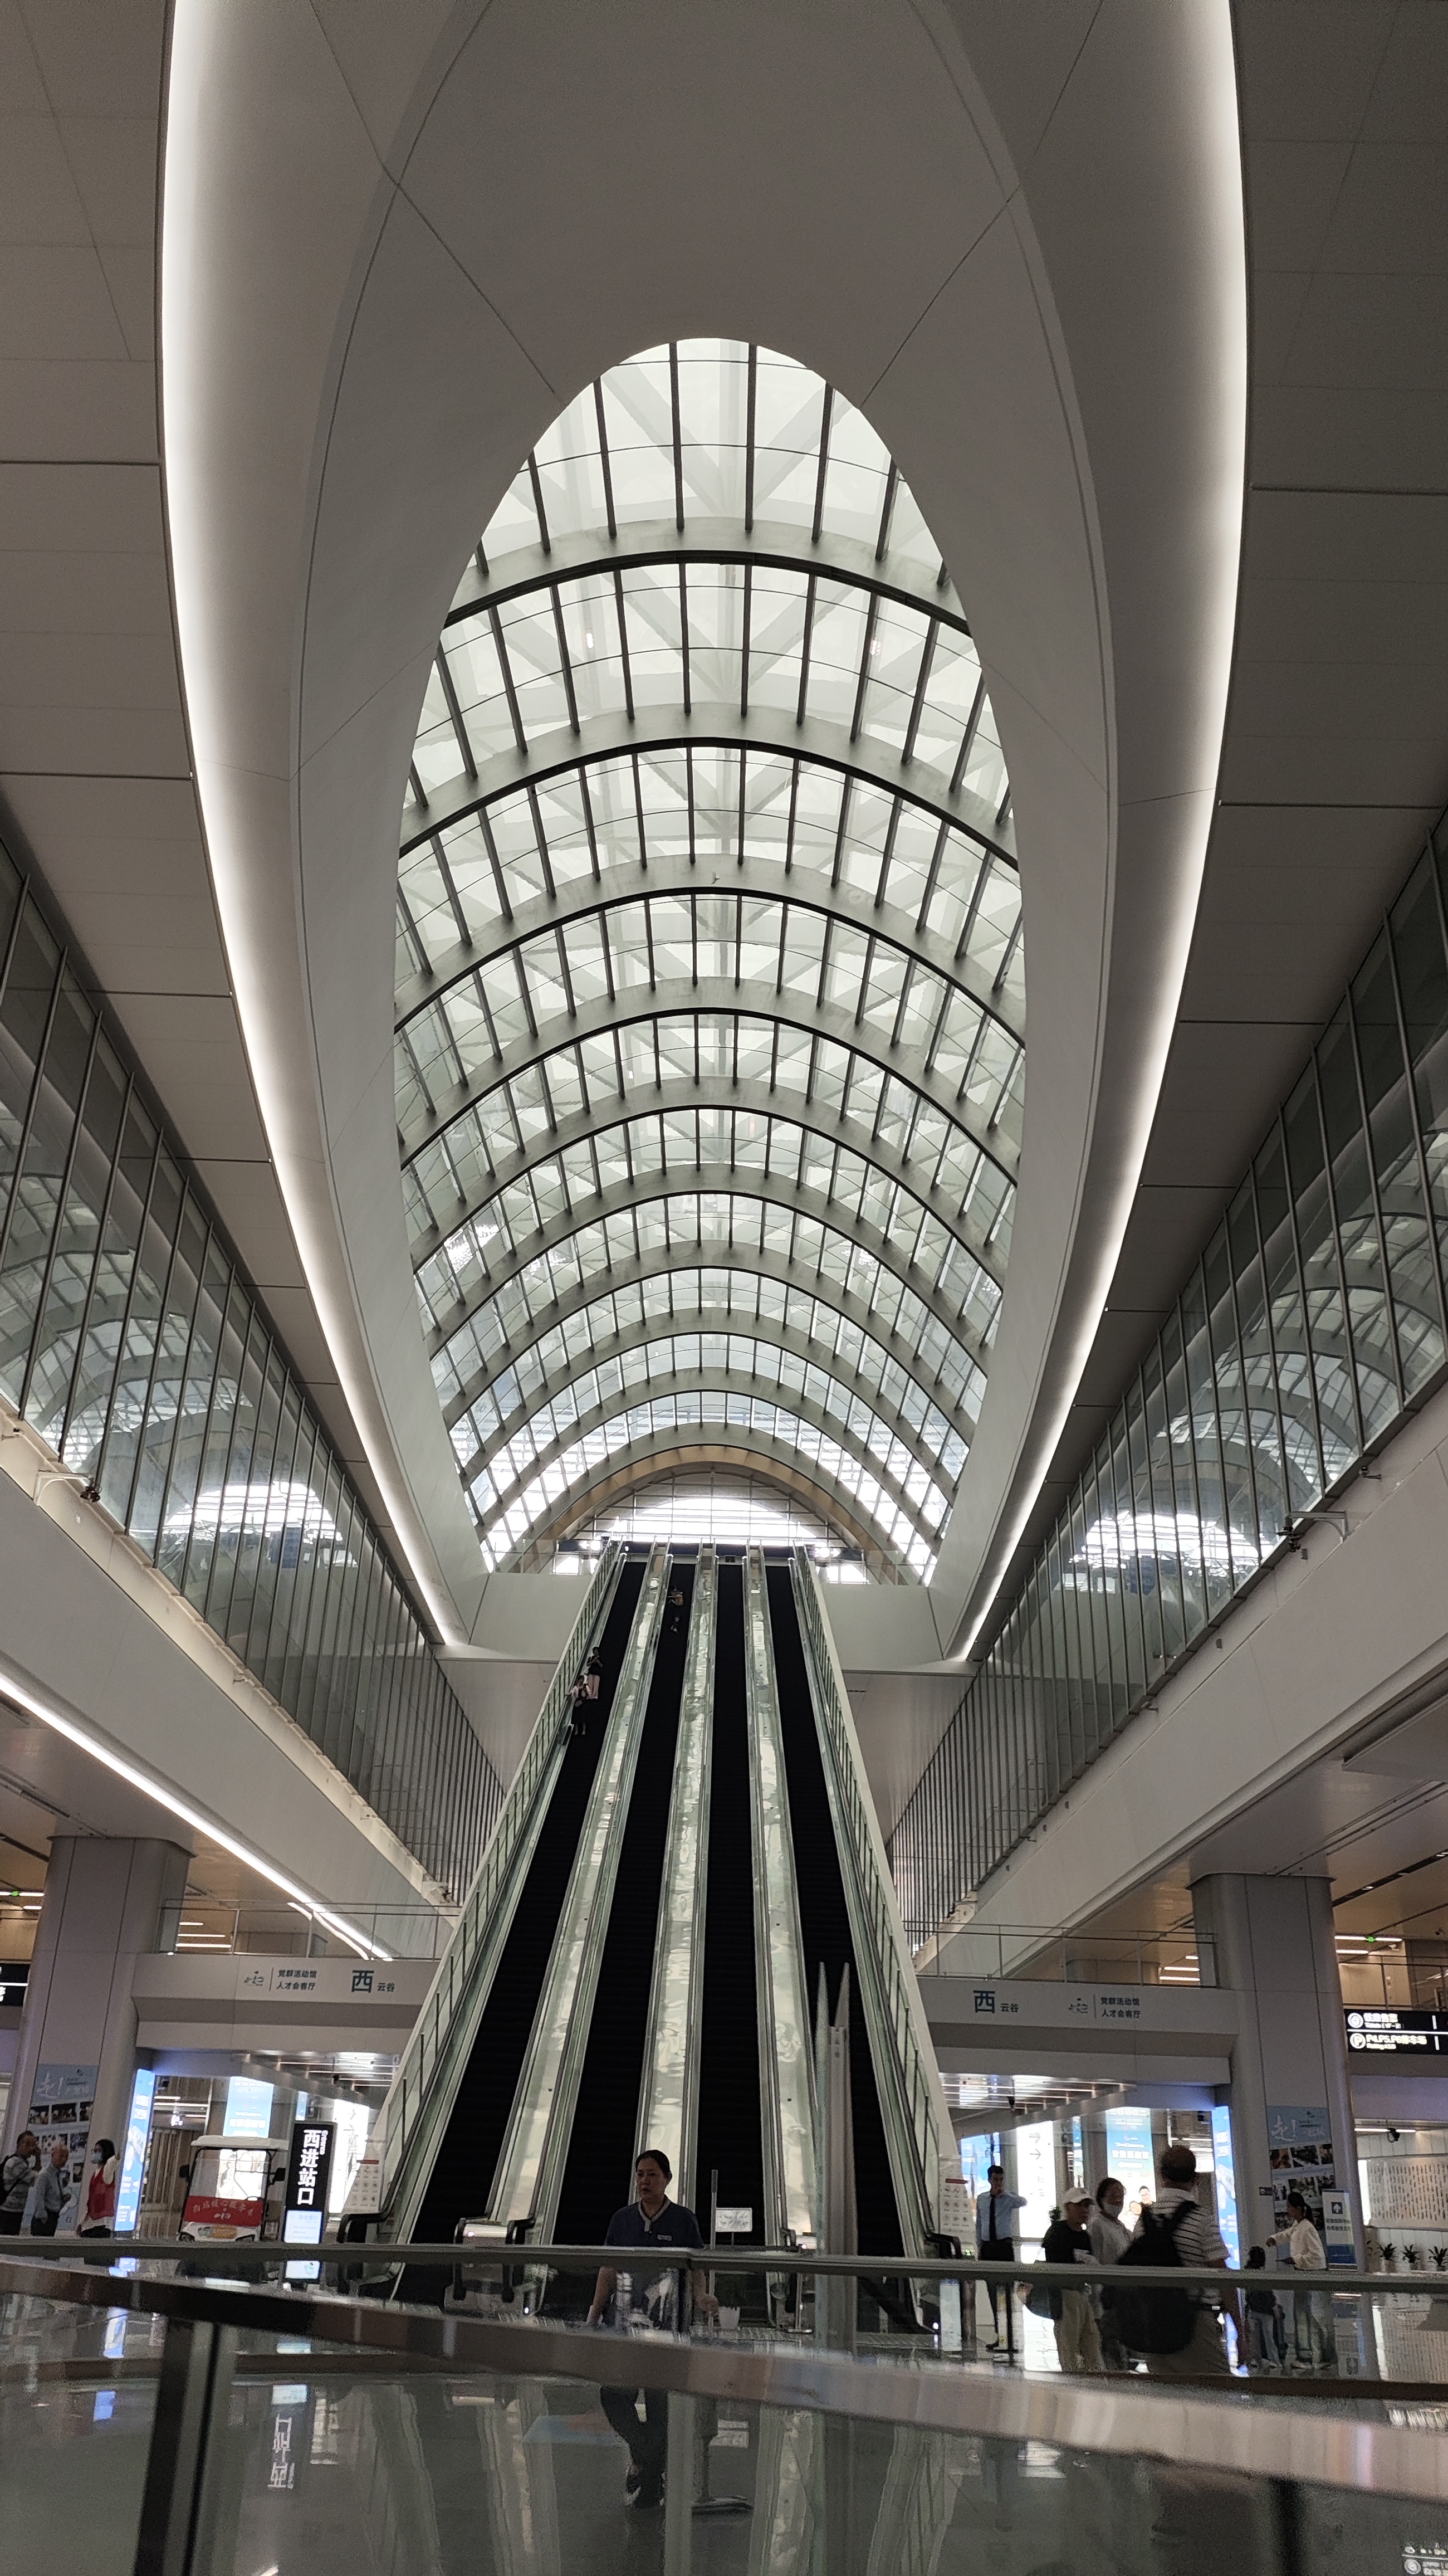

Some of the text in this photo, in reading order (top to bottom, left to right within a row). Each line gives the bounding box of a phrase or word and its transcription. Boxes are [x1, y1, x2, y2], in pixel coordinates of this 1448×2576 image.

[278, 1969, 317, 1978] 党群活动馆
[276, 1982, 316, 1990] 人才会客厅
[351, 1970, 395, 1993] 西 云谷
[973, 1990, 1019, 2013] 西 云谷
[1100, 1997, 1140, 2006] 党群活动馆
[1101, 2009, 1141, 2019] 人才会客厅
[297, 2129, 322, 2205] 西进站口
